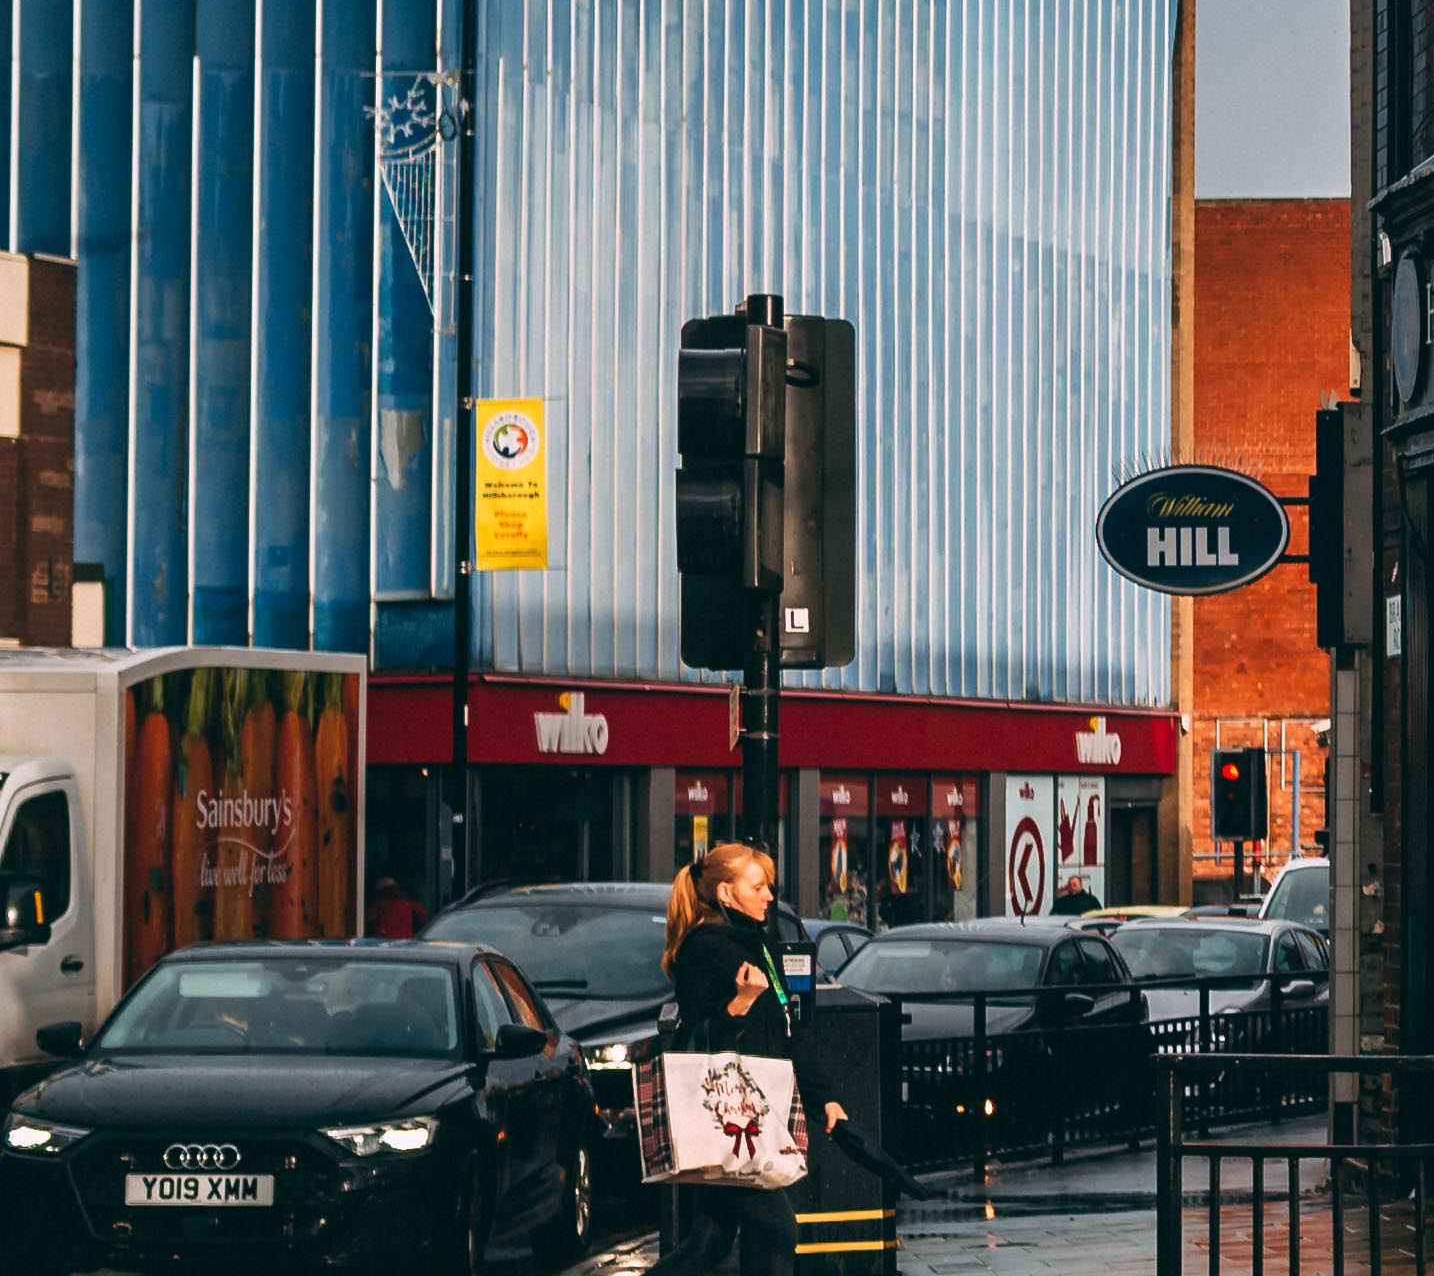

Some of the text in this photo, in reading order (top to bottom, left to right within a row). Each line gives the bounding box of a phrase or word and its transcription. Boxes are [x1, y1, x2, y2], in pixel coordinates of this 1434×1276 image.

[1148, 492, 1236, 519] William
[1147, 527, 1239, 567] HILL
[791, 610, 804, 629] L
[534, 692, 608, 755] wilko
[1075, 716, 1121, 765] wilko
[197, 788, 292, 835] Sainsbury's
[143, 1177, 257, 1200] YO19 XMM
